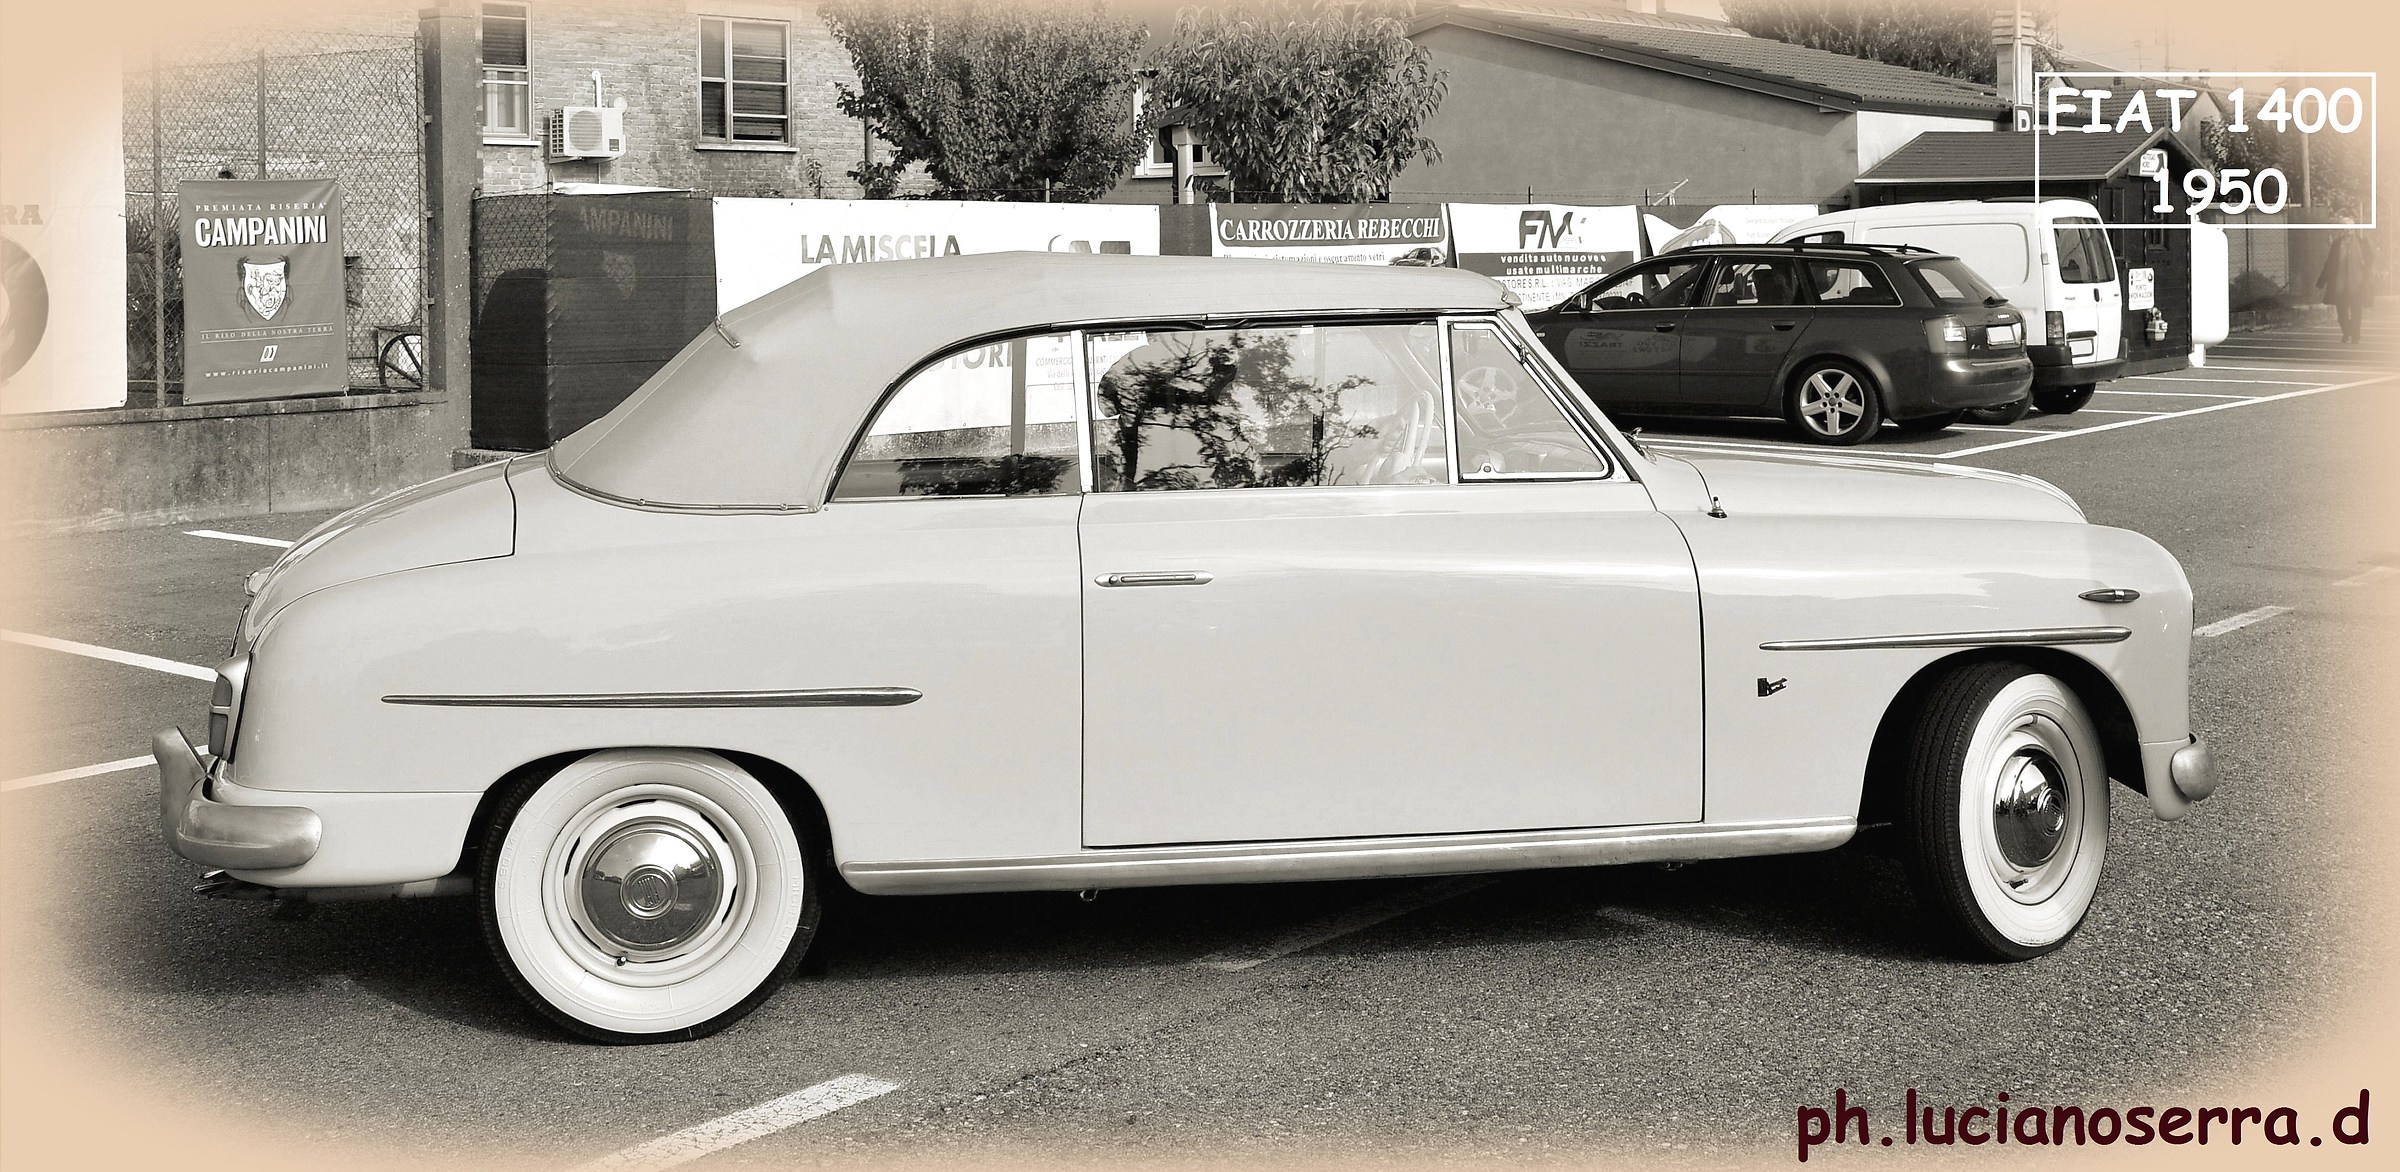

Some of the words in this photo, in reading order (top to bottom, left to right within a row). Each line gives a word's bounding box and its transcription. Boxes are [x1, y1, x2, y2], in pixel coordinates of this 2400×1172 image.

[195, 203, 262, 212] PREMIATA
[270, 202, 325, 211] RISERIA
[580, 205, 674, 241] AMPANINI
[1219, 218, 1355, 241] CARROZZERIA
[1357, 217, 1441, 239] REBECCHI
[194, 215, 328, 248] CAMPANINI
[1500, 253, 1539, 263] vendita
[1540, 253, 1562, 263] auto
[1506, 265, 1534, 275] usate
[1535, 264, 1603, 275] multimarche
[271, 327, 303, 336] NOSTRA
[308, 325, 334, 333] TERRA
[205, 362, 329, 378] www.riseriacampanini.it
